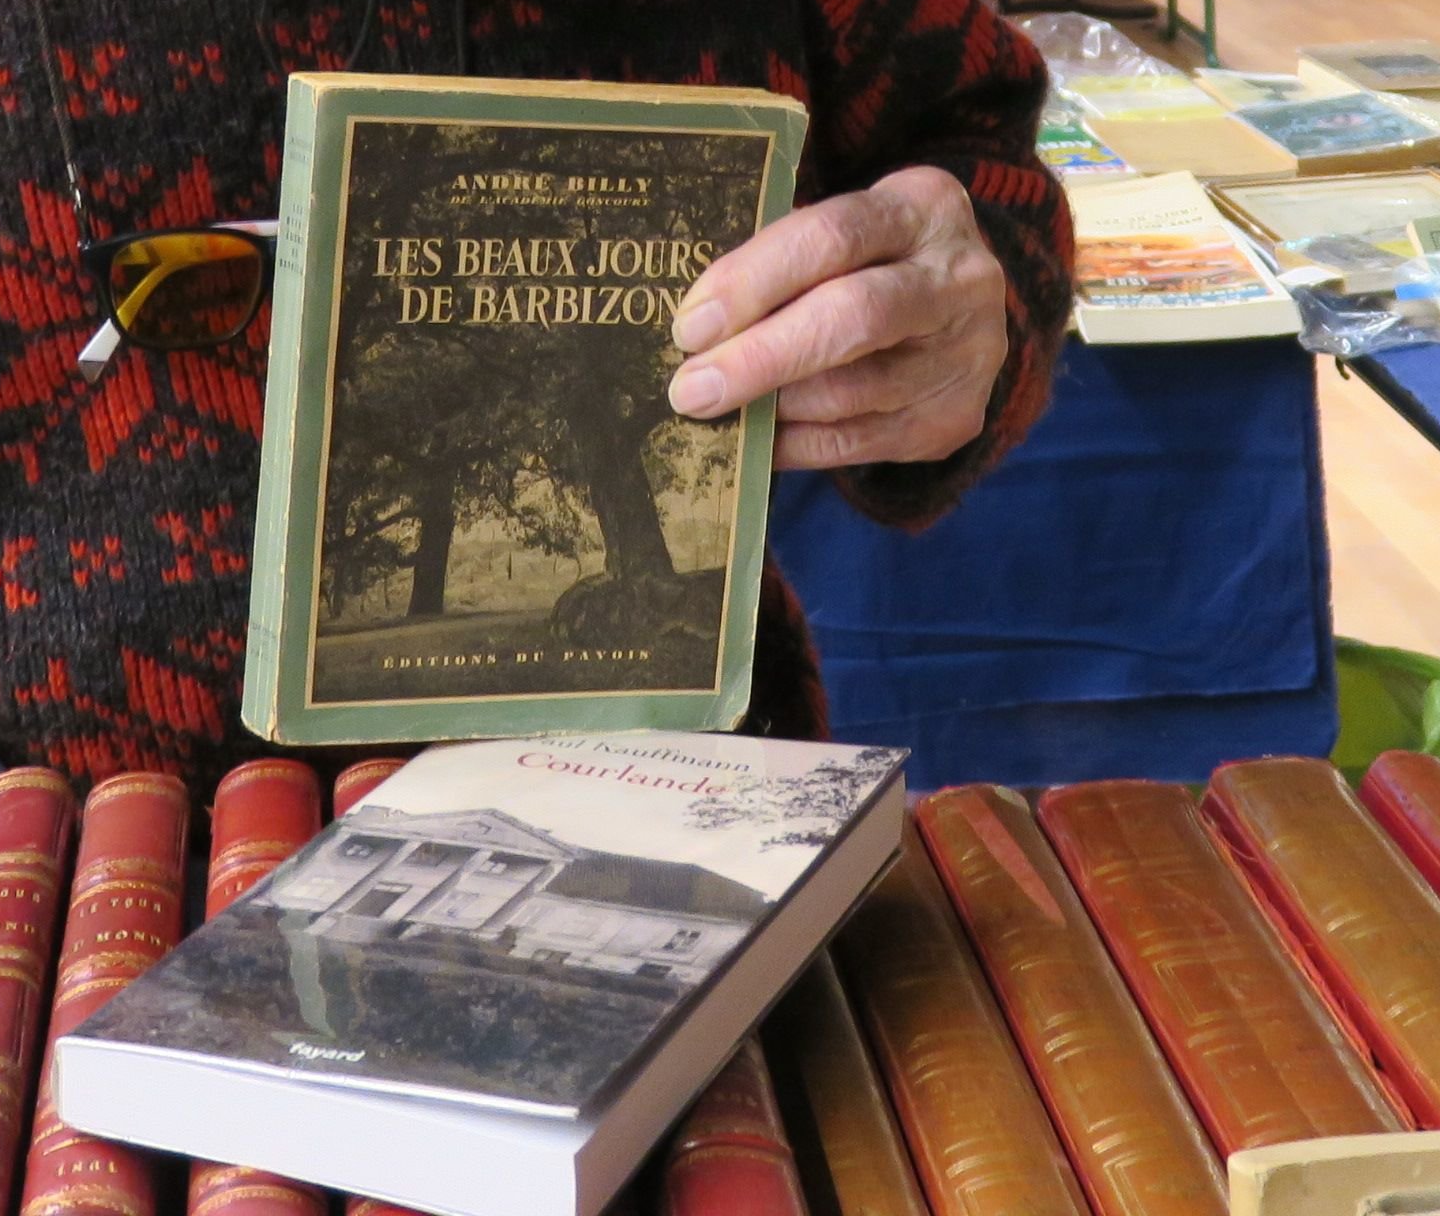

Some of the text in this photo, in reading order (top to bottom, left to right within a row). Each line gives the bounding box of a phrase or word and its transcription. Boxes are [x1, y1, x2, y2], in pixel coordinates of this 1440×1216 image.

[566, 175, 652, 193] BILLY
[577, 196, 651, 207] GONCOURT
[372, 238, 713, 280] LES BEAUX JOURS
[398, 285, 683, 330] DE BARBIZON
[515, 651, 544, 664] DU
[562, 648, 651, 662] PAVOIS
[593, 741, 750, 773] Kauffmann
[517, 752, 727, 796] Courlande
[288, 1041, 366, 1062] fayard
